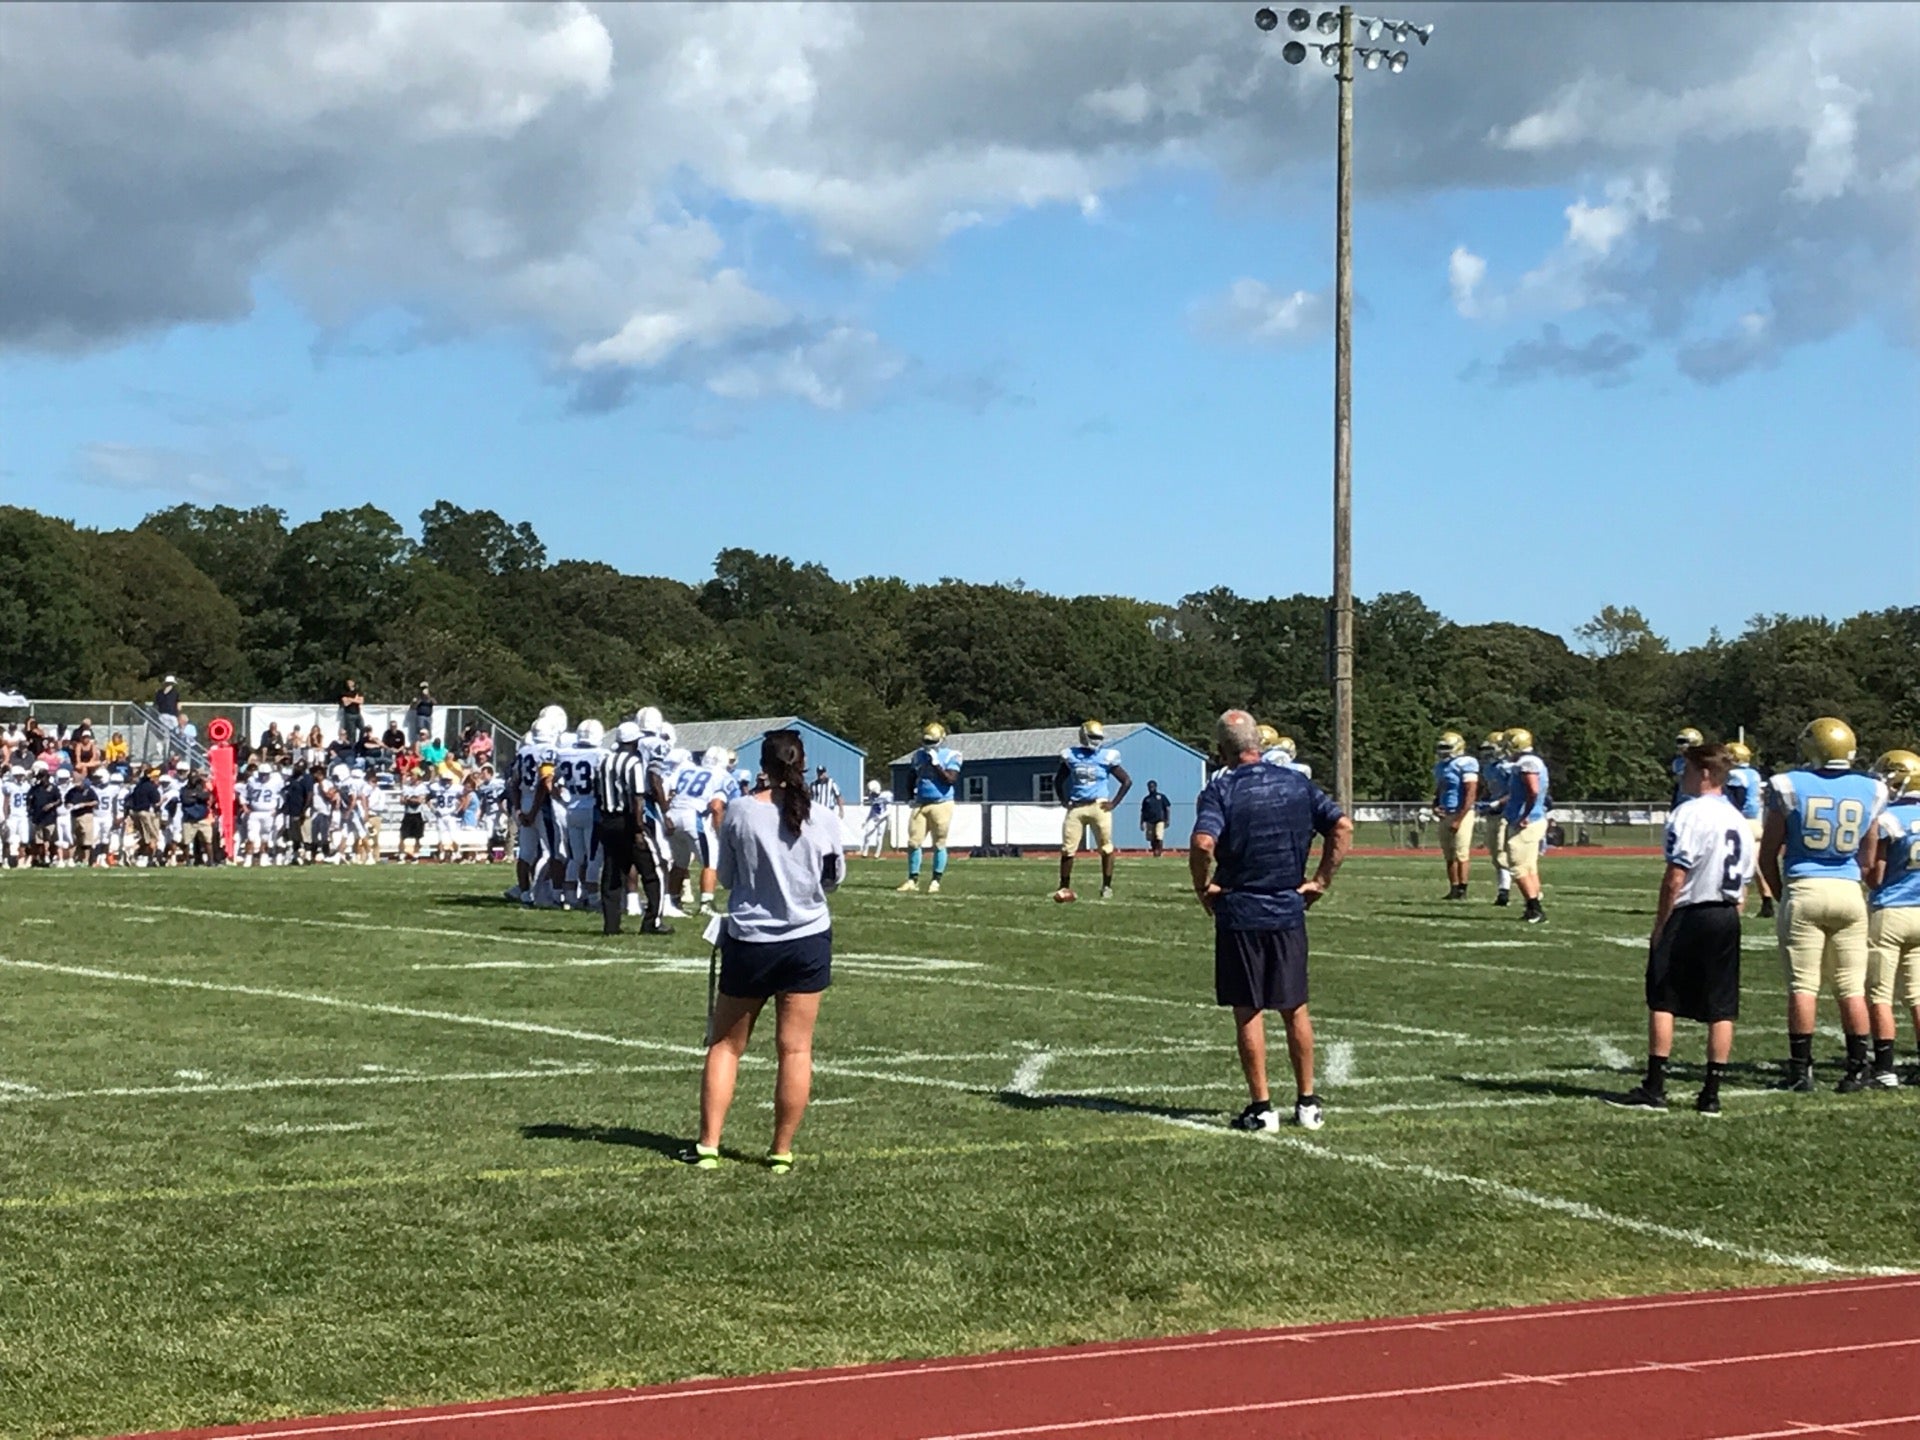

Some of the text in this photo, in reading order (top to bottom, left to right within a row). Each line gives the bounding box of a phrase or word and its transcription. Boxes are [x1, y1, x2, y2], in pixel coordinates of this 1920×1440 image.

[252, 788, 273, 803] 72
[675, 769, 712, 798] 68
[1803, 796, 1864, 853] 58
[1722, 829, 1743, 891] 2
